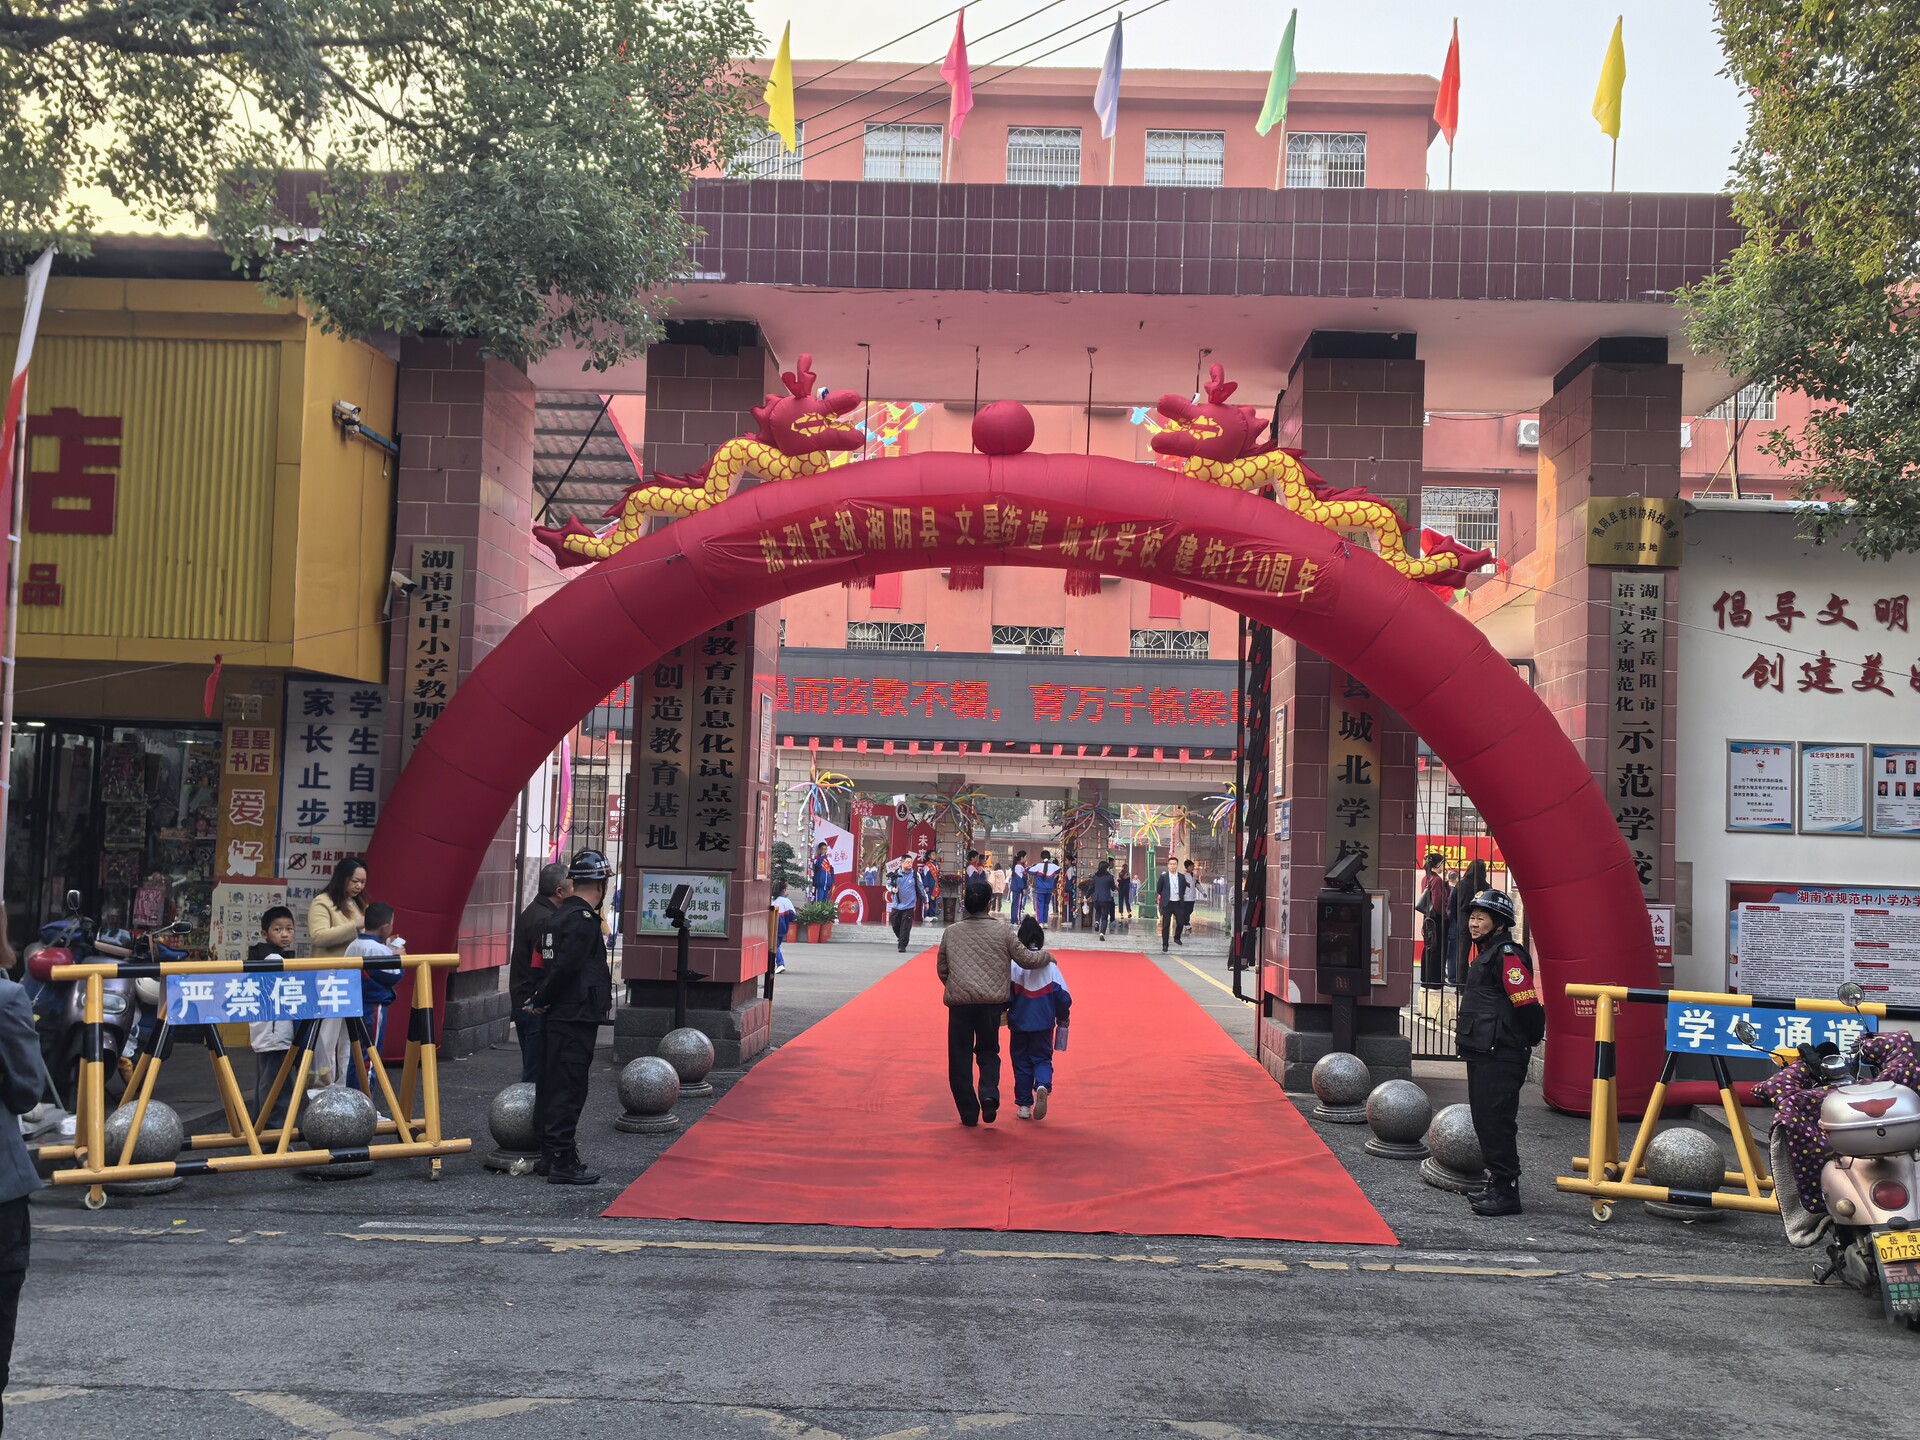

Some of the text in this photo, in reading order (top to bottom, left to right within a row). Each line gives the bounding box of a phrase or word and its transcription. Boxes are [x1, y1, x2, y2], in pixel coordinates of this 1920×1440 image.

[1613, 542, 1659, 552] 示范基地
[1712, 590, 1910, 634] 倡导文明
[1615, 583, 1636, 713] 语言文字规范化
[1638, 583, 1660, 713] 湖南省岳阳市
[231, 729, 271, 750] 星星
[297, 688, 336, 828] 家长止步
[645, 643, 684, 850] 创造教育基地
[695, 619, 737, 853] 教育信息化试点学校
[230, 752, 271, 773] 书店
[343, 690, 382, 829] 学生自理
[648, 898, 721, 912] 全国明城市
[179, 976, 352, 1020] 严禁停车
[1677, 1008, 1866, 1053] 学生通道
[1888, 1234, 1918, 1245] 岳阳
